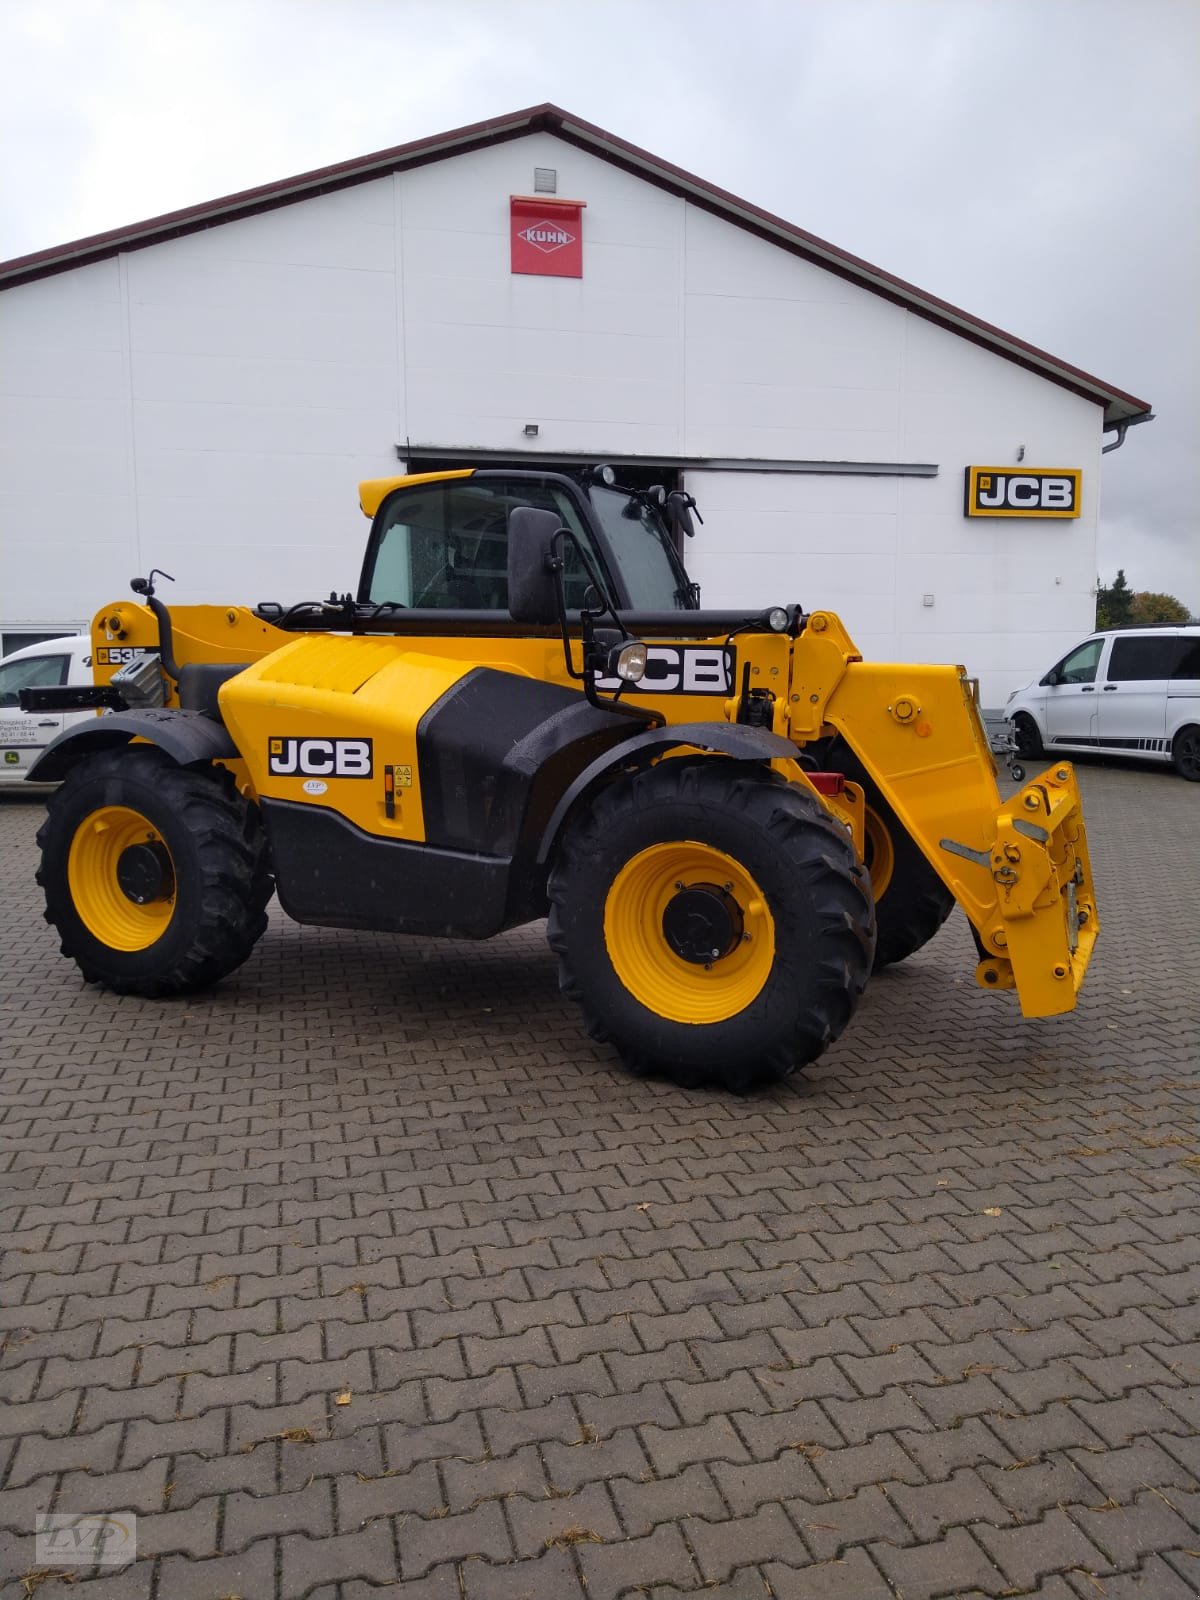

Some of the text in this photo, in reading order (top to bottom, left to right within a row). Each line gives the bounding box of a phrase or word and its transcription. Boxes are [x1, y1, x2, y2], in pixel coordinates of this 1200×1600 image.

[526, 229, 568, 243] KUHN
[979, 476, 1073, 508] JCB
[270, 740, 371, 775] JCB
